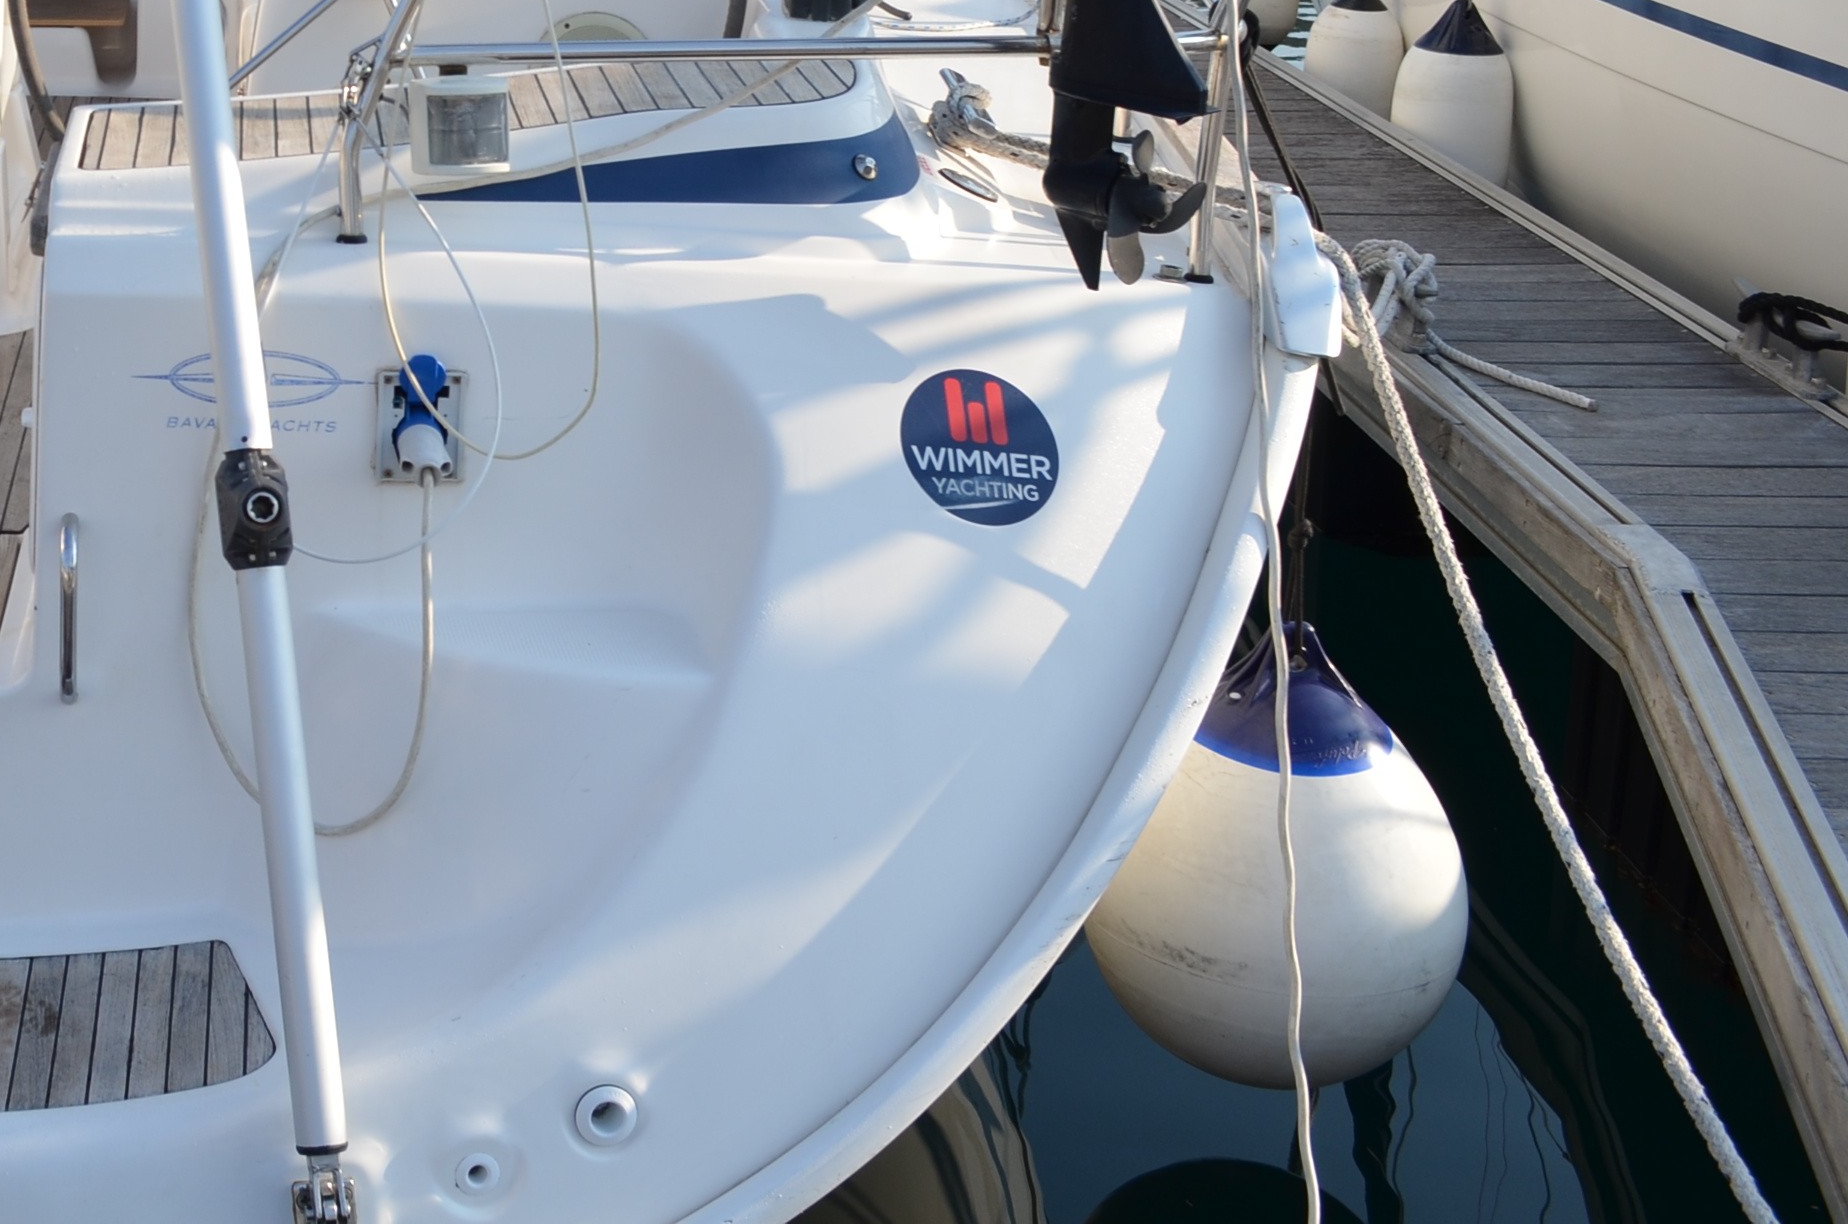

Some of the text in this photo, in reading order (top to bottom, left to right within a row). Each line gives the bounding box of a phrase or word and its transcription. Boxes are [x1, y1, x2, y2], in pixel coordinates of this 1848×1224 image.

[165, 416, 338, 433] BAVA ACHTS
[910, 444, 1053, 481] WIMMER
[931, 476, 1040, 502] YACHTING
